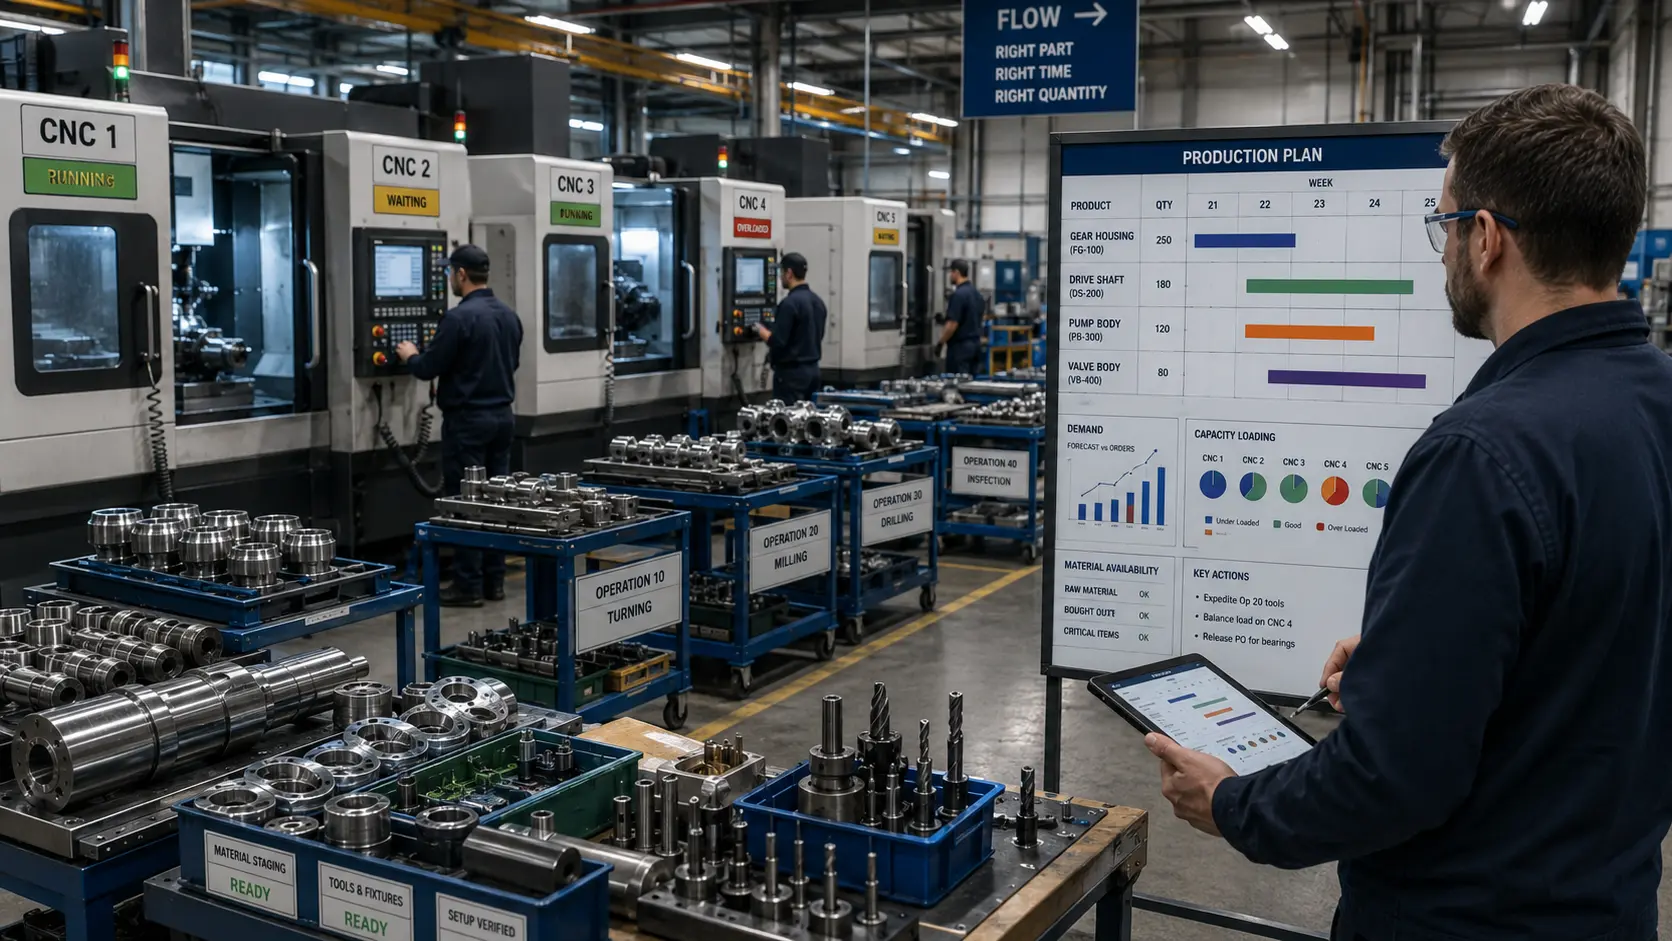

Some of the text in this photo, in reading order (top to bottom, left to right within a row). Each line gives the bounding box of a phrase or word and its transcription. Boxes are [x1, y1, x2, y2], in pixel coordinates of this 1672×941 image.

[998, 5, 1061, 30] FLOW
[996, 42, 1074, 59] RIGHT PART
[996, 64, 1071, 81] RIGHT TIME
[996, 85, 1107, 103] RIGHT QUANTITY
[40, 118, 116, 148] CNC 1
[1183, 148, 1322, 164] PRODUCTION PLAN
[383, 155, 430, 177] CNC 2
[558, 175, 594, 194] CNC 3
[1309, 179, 1333, 187] WEEK
[387, 194, 427, 208] WAITING
[739, 195, 766, 211] CNC 4
[1071, 201, 1111, 210] PRODUCT
[1156, 200, 1173, 211] QTY
[1208, 201, 1218, 209] 21
[1260, 200, 1270, 208] 22
[1314, 200, 1325, 208] 23
[1369, 199, 1380, 208] 24
[1424, 198, 1436, 207] 25
[1070, 231, 1134, 240] GEAR HOUSING
[1156, 236, 1172, 244] 250
[1070, 245, 1104, 255] (FG-100)
[1070, 275, 1124, 284] DRIVE SHAFT
[1156, 280, 1171, 288] 180
[1070, 289, 1104, 299] (DS-200)
[1069, 319, 1121, 328] PUMP BODY
[1156, 324, 1170, 333] 120
[1069, 332, 1103, 342] (PB-300)
[1068, 362, 1121, 372] VALVE BODY
[1158, 368, 1168, 376] 80
[1068, 375, 1102, 386] (VB-400)
[1068, 424, 1104, 434] DEMAND
[1194, 430, 1275, 442] CAPACITY LOADING
[1067, 442, 1099, 450] FORECAST
[1109, 444, 1135, 452] ORDERS
[964, 456, 1017, 468] OPERATION 40
[1203, 454, 1218, 462] CNC
[1242, 456, 1258, 464] CNC
[1283, 458, 1298, 466] CNC
[1324, 460, 1340, 468] CNC
[1366, 462, 1382, 470] CNC
[968, 474, 1011, 486] INSPECTION
[873, 490, 922, 508] OPERATION 30
[881, 512, 914, 528] DRILLING
[1284, 521, 1302, 529] Good
[1345, 525, 1368, 533] Loaded
[764, 525, 819, 548] OPERATION 20
[775, 551, 807, 570] MILLING
[1064, 560, 1159, 575] MATERIAL AVAILABILITY
[1194, 569, 1249, 581] KEY ACTIONS
[596, 570, 664, 599] OPERATION 10
[1064, 585, 1118, 596] RAW MATERIAL
[1139, 590, 1149, 598] OK
[1204, 594, 1285, 608] Expedite Op 20 tools
[607, 600, 652, 624] TURNING
[1064, 606, 1094, 615] BOUGHT
[1139, 612, 1149, 620] OK
[1204, 613, 1292, 628] Balance load on CNC 4
[1064, 627, 1119, 639] CRITICAL ITEMS
[1203, 632, 1296, 649] Release PO for bearings
[214, 844, 286, 874] MATERIAL STAGING
[230, 877, 270, 902] READY
[329, 877, 403, 907] TOOLS & FIXTURES
[345, 910, 388, 936] READY
[448, 909, 516, 938] SETUP VERIFIED
